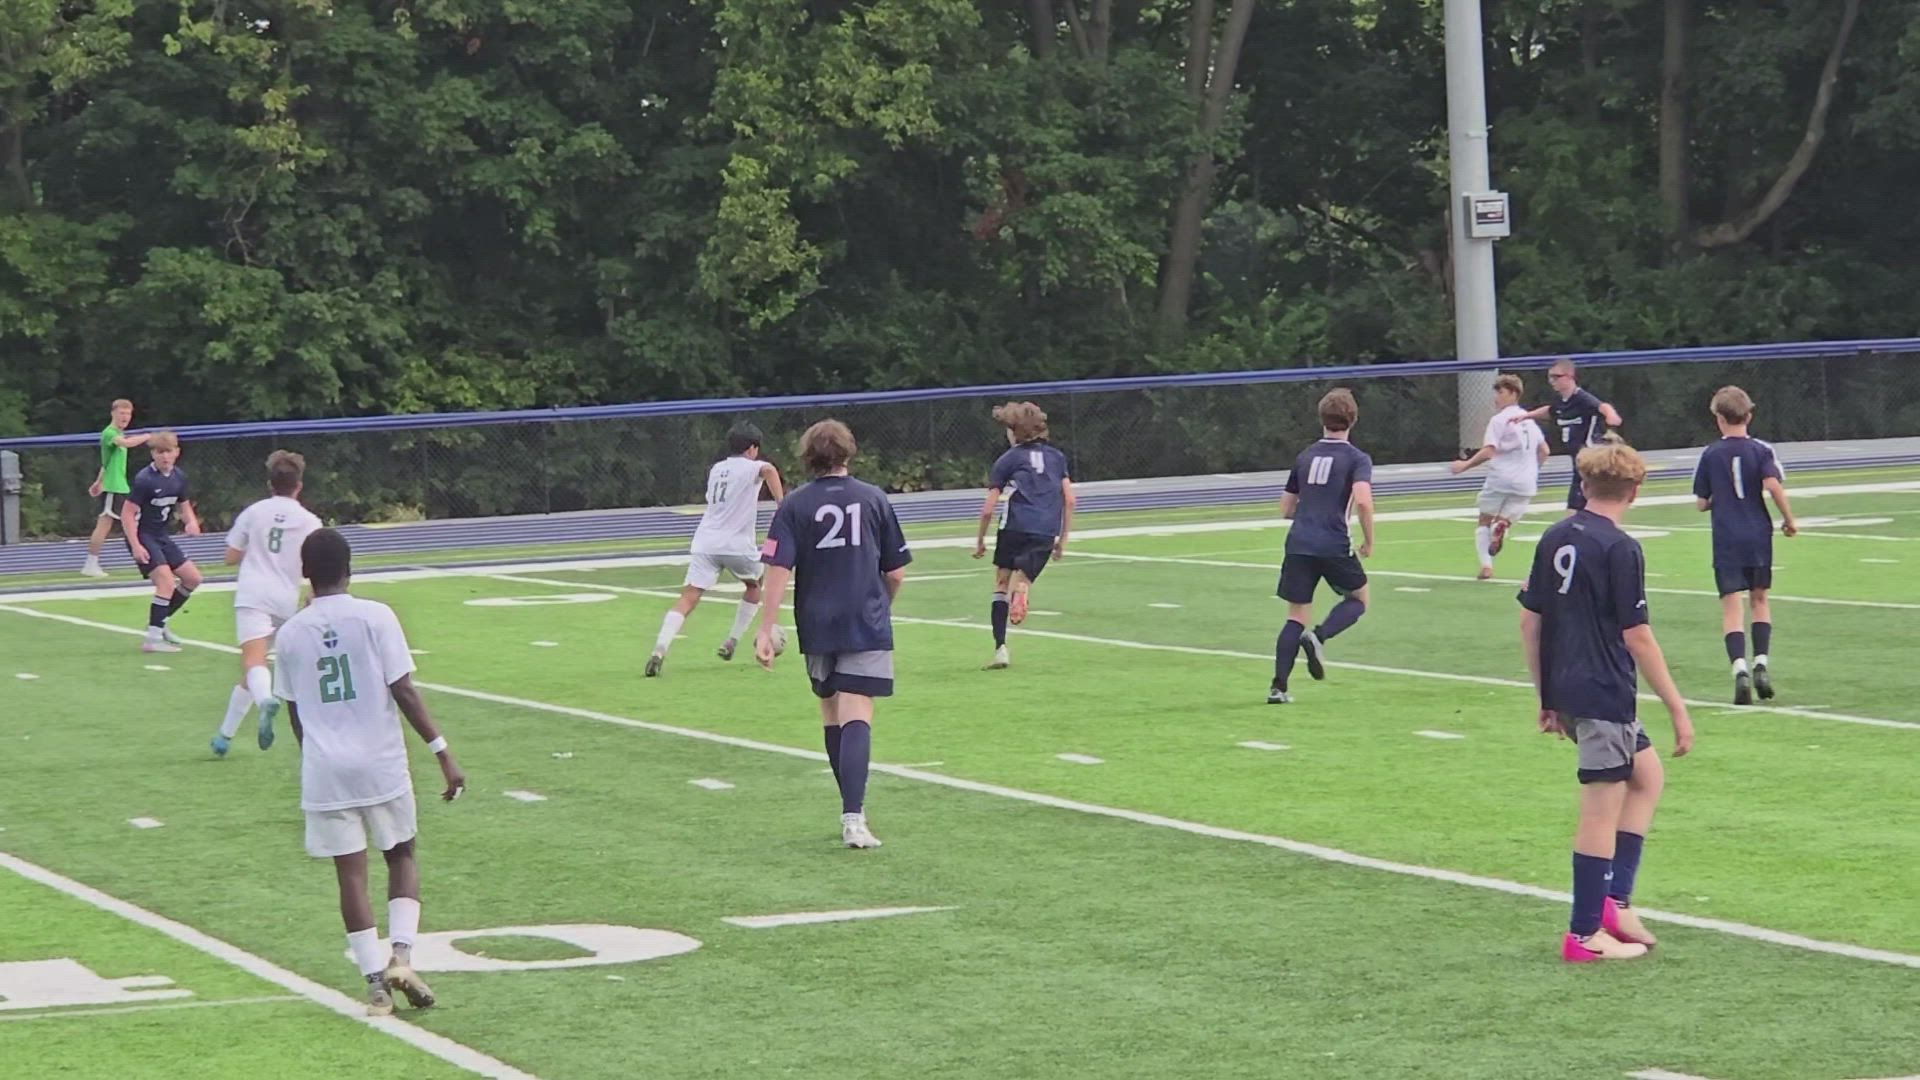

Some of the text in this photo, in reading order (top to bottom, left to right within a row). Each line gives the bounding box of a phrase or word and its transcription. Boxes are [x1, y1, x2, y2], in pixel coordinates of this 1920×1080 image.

[1307, 456, 1334, 485] 10
[1732, 456, 1745, 499] 1
[268, 526, 284, 554] 8
[814, 502, 861, 549] 21
[1553, 544, 1576, 595] 9
[316, 653, 357, 703] 21
